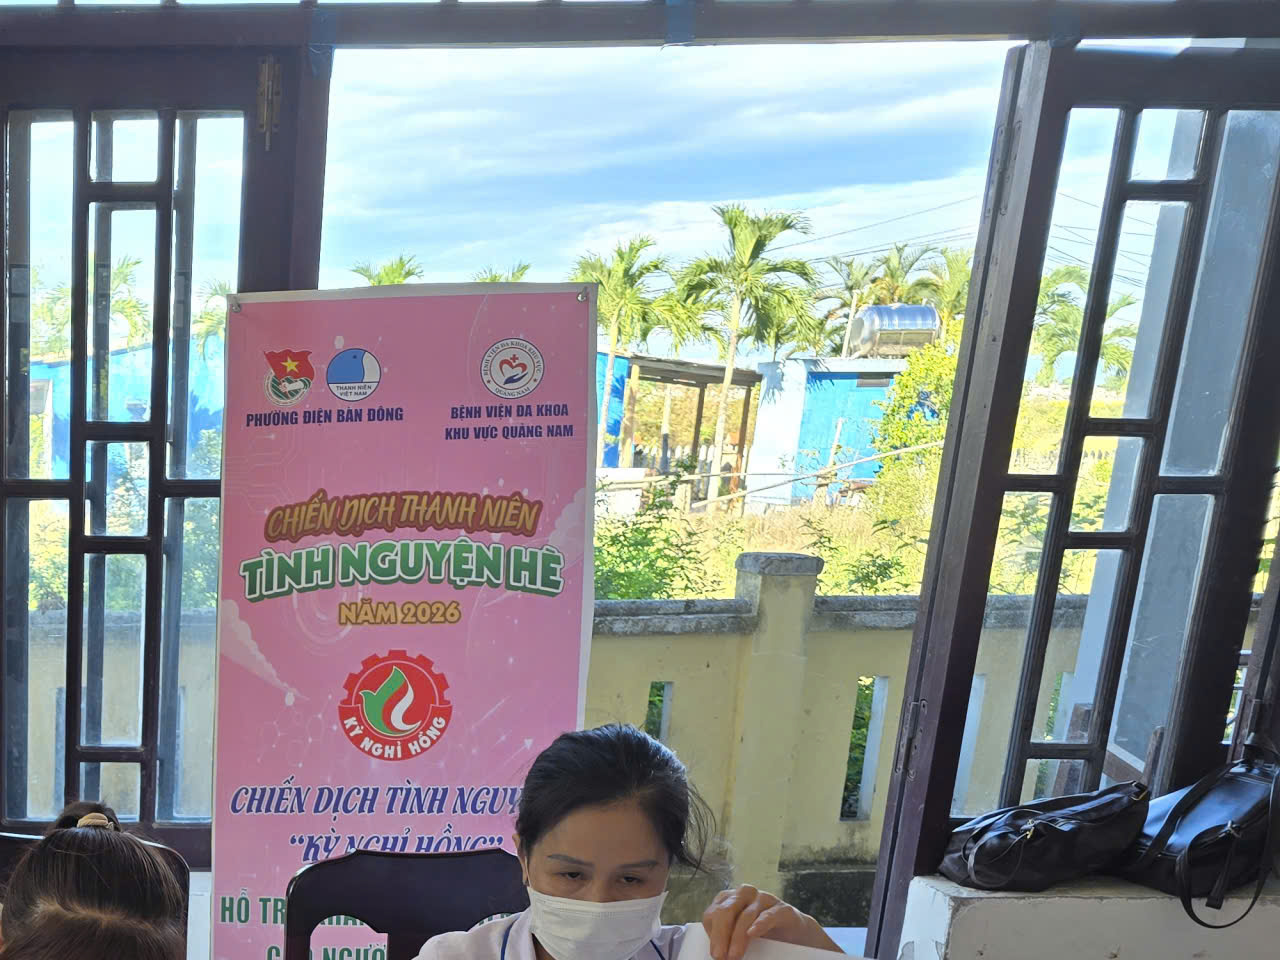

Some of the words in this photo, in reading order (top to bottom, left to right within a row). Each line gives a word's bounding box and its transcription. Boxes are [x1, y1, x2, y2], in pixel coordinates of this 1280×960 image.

[246, 410, 298, 427] PHƯỜNG
[303, 407, 332, 426] ĐIỆN
[367, 405, 404, 422] ĐÔNG
[450, 404, 482, 421] BỆNH
[486, 403, 512, 420] VIỆN
[516, 404, 533, 418] ĐA
[536, 403, 569, 417] KHOA
[445, 427, 469, 441] KHU
[474, 424, 498, 441] VỰC
[547, 424, 573, 438] NAM
[267, 489, 338, 540] CHIẾN
[337, 494, 396, 534] DỊCH
[398, 492, 478, 526] THANH
[478, 494, 541, 533] NIÊN
[239, 546, 333, 602] TÌNH
[337, 537, 505, 589] NGUYỆN
[508, 546, 566, 596] HÈ
[337, 598, 397, 625] NĂM
[398, 601, 461, 623] 2026
[359, 740, 402, 758] NGHỈ
[407, 716, 446, 755] HỒNG
[230, 776, 310, 814] CHIẾN
[313, 786, 380, 821] DỊCH
[385, 779, 450, 814] TÌNH
[452, 786, 524, 814] NGUY
[220, 888, 250, 924] HỖ
[259, 897, 287, 925] TR
